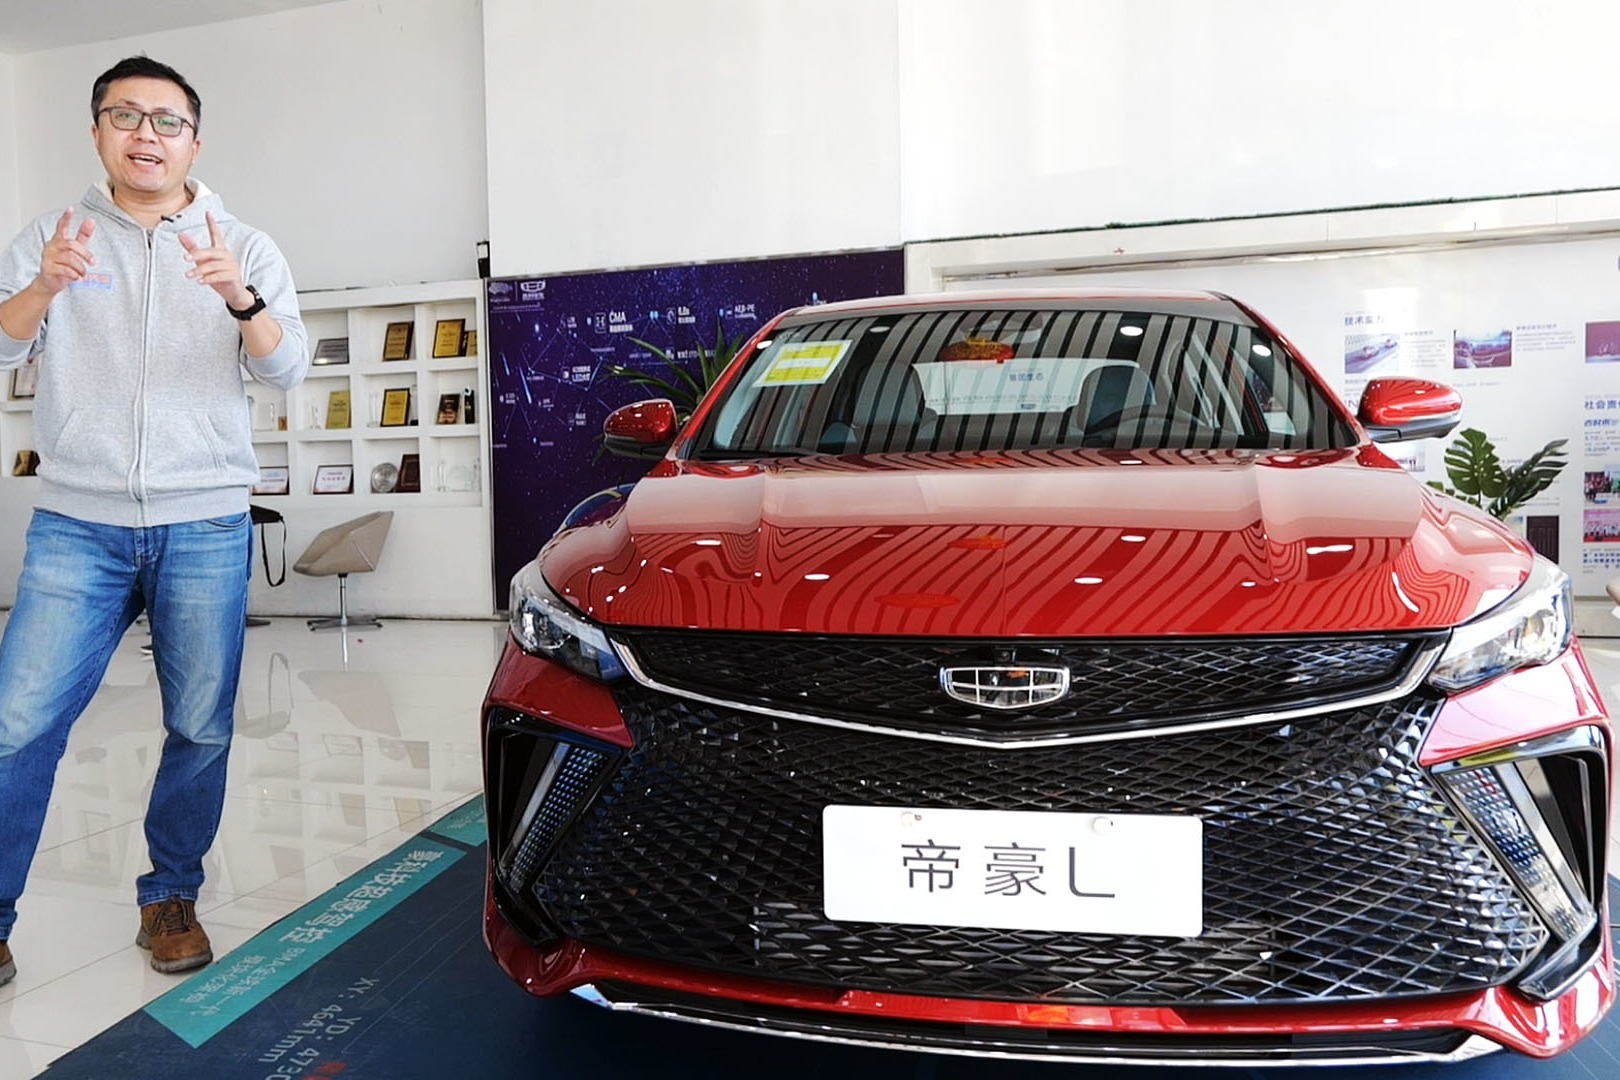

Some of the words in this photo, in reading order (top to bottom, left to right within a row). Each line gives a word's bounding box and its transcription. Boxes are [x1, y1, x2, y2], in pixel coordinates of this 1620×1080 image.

[608, 311, 627, 324] CMA
[1584, 399, 1620, 410] 社会责
[900, 838, 1116, 898] 帝豪L
